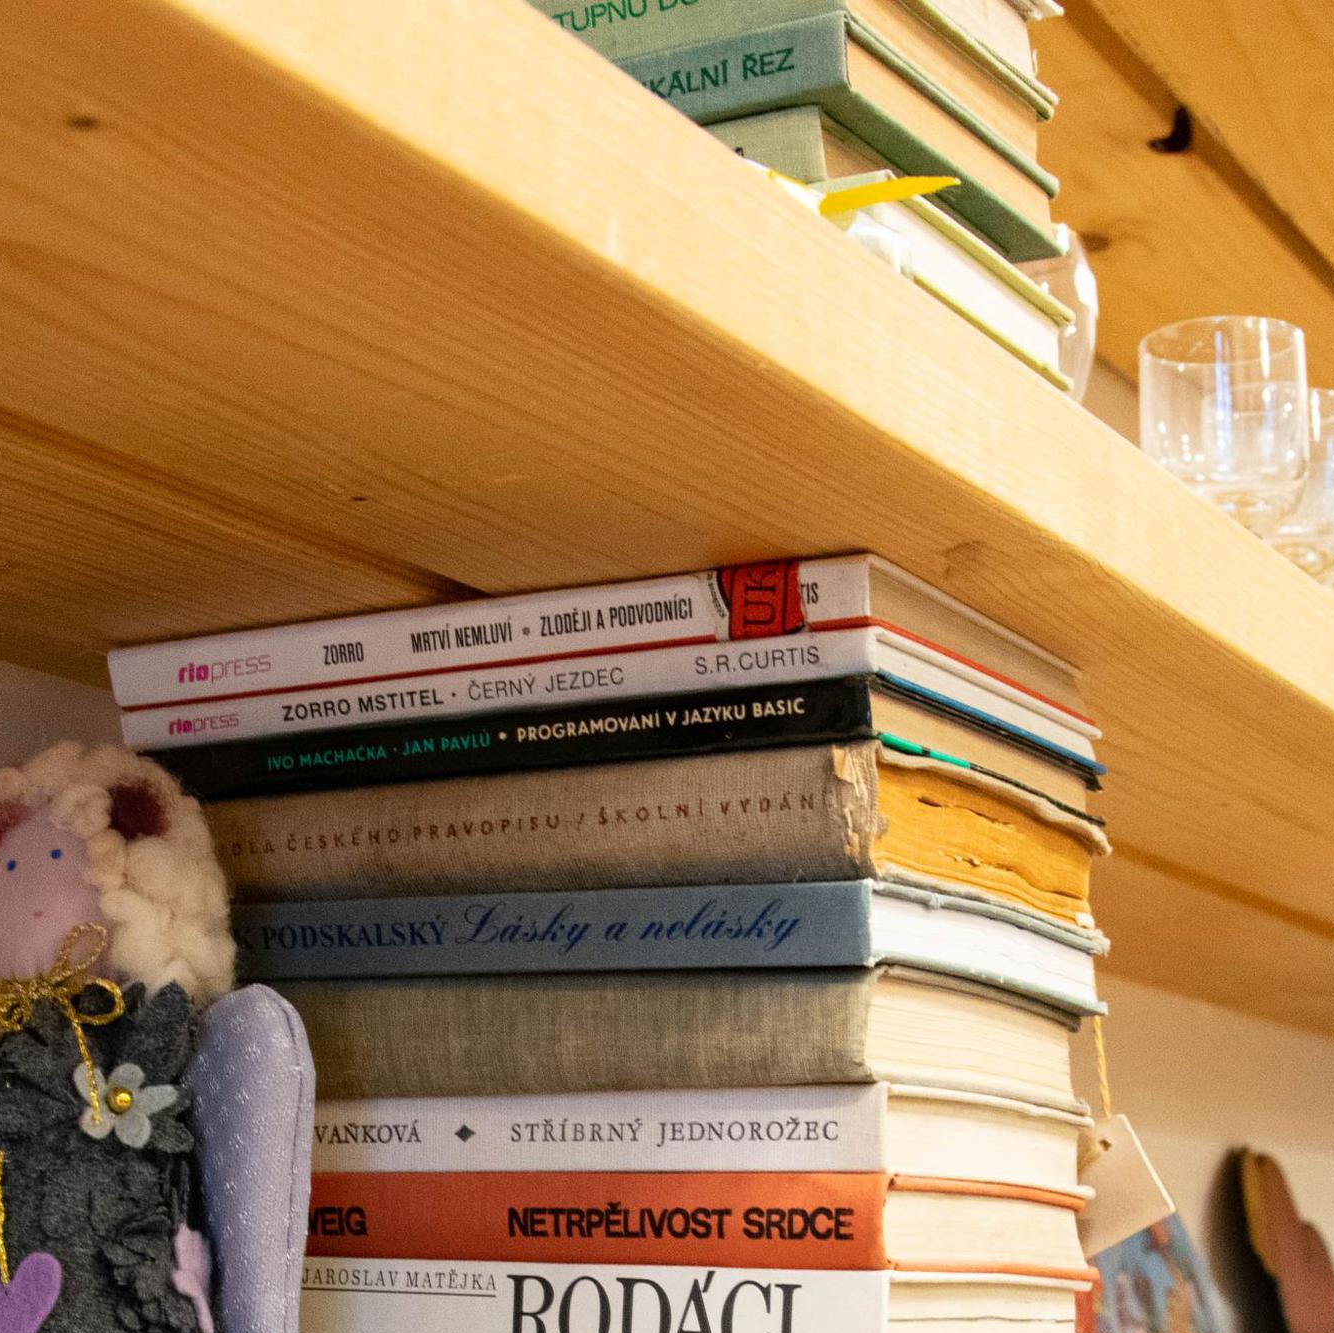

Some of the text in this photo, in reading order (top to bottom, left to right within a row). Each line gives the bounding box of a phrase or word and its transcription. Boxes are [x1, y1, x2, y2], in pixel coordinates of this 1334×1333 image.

[642, 48, 795, 98] KÁLNÍ ŘEZ
[323, 641, 365, 666] ZORRO
[410, 623, 452, 654] MRTVÍ
[454, 615, 513, 648] NEMLUVÍ
[539, 606, 592, 637] ZLODĚJI
[596, 609, 606, 629] A
[609, 593, 693, 630] PODVODNÍCI
[282, 698, 351, 722] ZORRO
[358, 688, 445, 714] MSTITEL
[467, 673, 536, 702] ČERNÝ
[545, 667, 625, 694] JEZDEC
[267, 756, 295, 771] IVO
[402, 738, 435, 757] JAN
[666, 710, 677, 725] V
[682, 705, 746, 727] JAZYKU
[753, 698, 806, 718] BASIC
[414, 814, 561, 842] PRAVOPISU
[267, 914, 448, 951] PODSKALSKÝ
[455, 903, 591, 952] Lásky
[604, 917, 629, 942] a
[640, 899, 802, 952] nelásky
[510, 1116, 644, 1144] STŘÍBRNÝ
[656, 1116, 840, 1148] JEDNOROŽEC
[507, 1201, 732, 1240] NETRPĚLIVOST
[742, 1207, 854, 1241] SRDCE
[302, 1267, 497, 1292] JAROSLAV MATĚJKA
